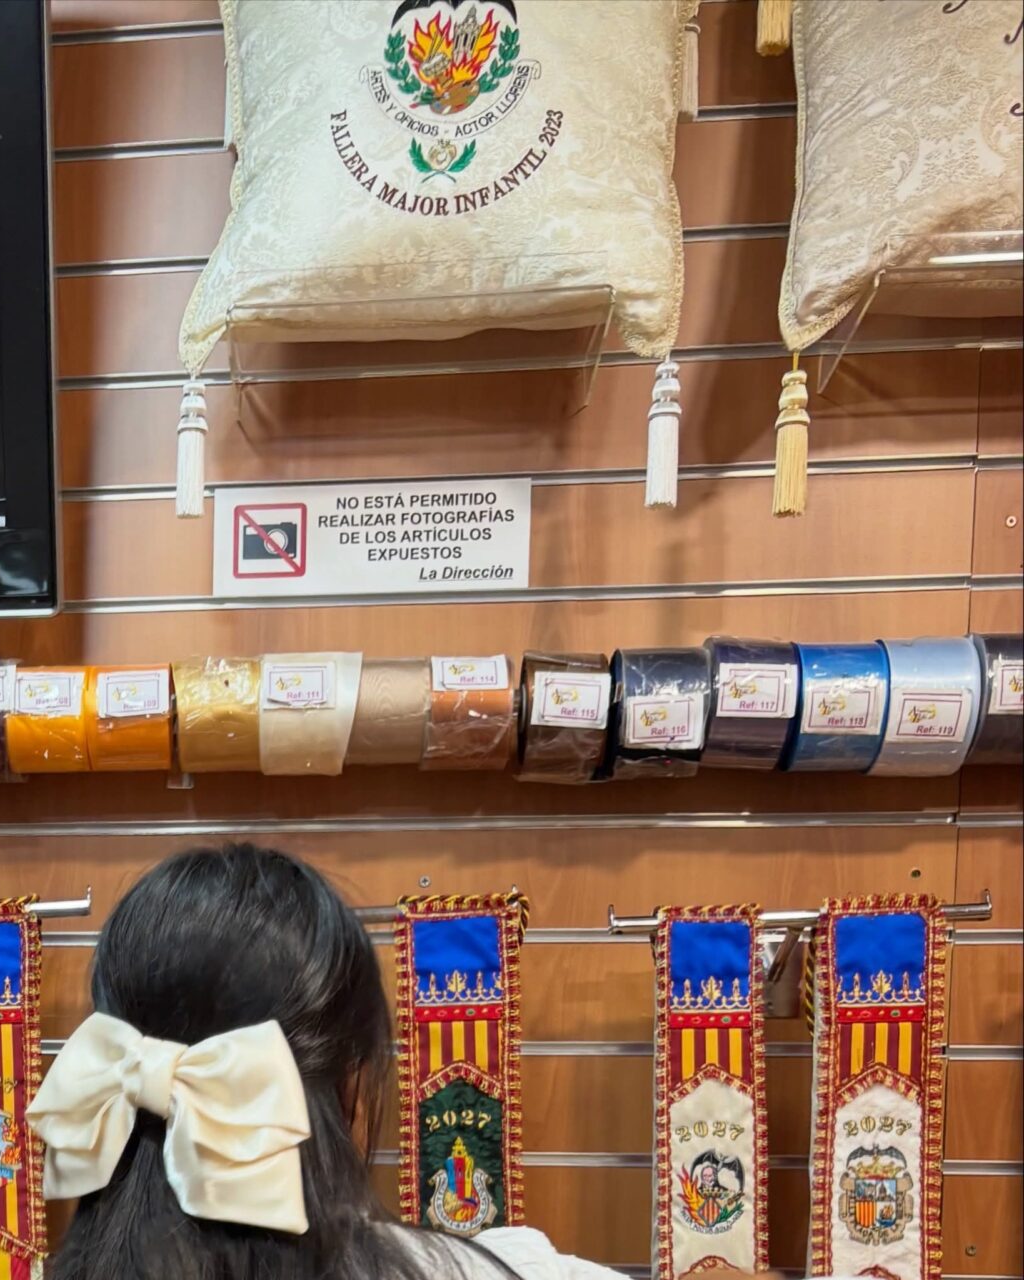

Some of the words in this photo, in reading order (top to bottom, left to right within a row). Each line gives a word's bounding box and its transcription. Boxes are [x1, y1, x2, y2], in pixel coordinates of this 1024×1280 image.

[369, 69, 390, 104] ARTES
[385, 102, 397, 115] Y
[395, 112, 440, 137] OFICIOS
[454, 111, 498, 138] ACTOR
[496, 65, 530, 117] LLORENS
[330, 108, 377, 192] FALLERA
[376, 181, 450, 216] MAJOR
[455, 147, 548, 215] INFANTIL
[539, 109, 565, 147] 2023
[335, 497, 360, 510] NO
[363, 491, 404, 510] ESTÁ
[409, 491, 498, 508] PERMITIDO
[317, 512, 396, 528] REALIZAR
[400, 507, 516, 527] FOTOGRAFÍAS
[339, 531, 361, 545] DE
[364, 529, 397, 544] LOS
[400, 526, 493, 543] ARTÍCULOS
[367, 545, 463, 562] EXPUESTOS
[419, 567, 438, 581] La
[441, 564, 515, 580] Dirección
[560, 706, 579, 717] Ref:
[580, 707, 597, 718] 115
[738, 700, 759, 710] Ref:
[760, 700, 775, 710] 117
[827, 716, 846, 726] Ref:
[848, 716, 864, 726] 118
[915, 724, 935, 735] Ref:
[937, 725, 954, 736] 119
[650, 727, 669, 736] Ref:
[425, 1109, 492, 1133] 2027
[843, 1115, 913, 1138] 2027
[675, 1120, 745, 1143] 2027
